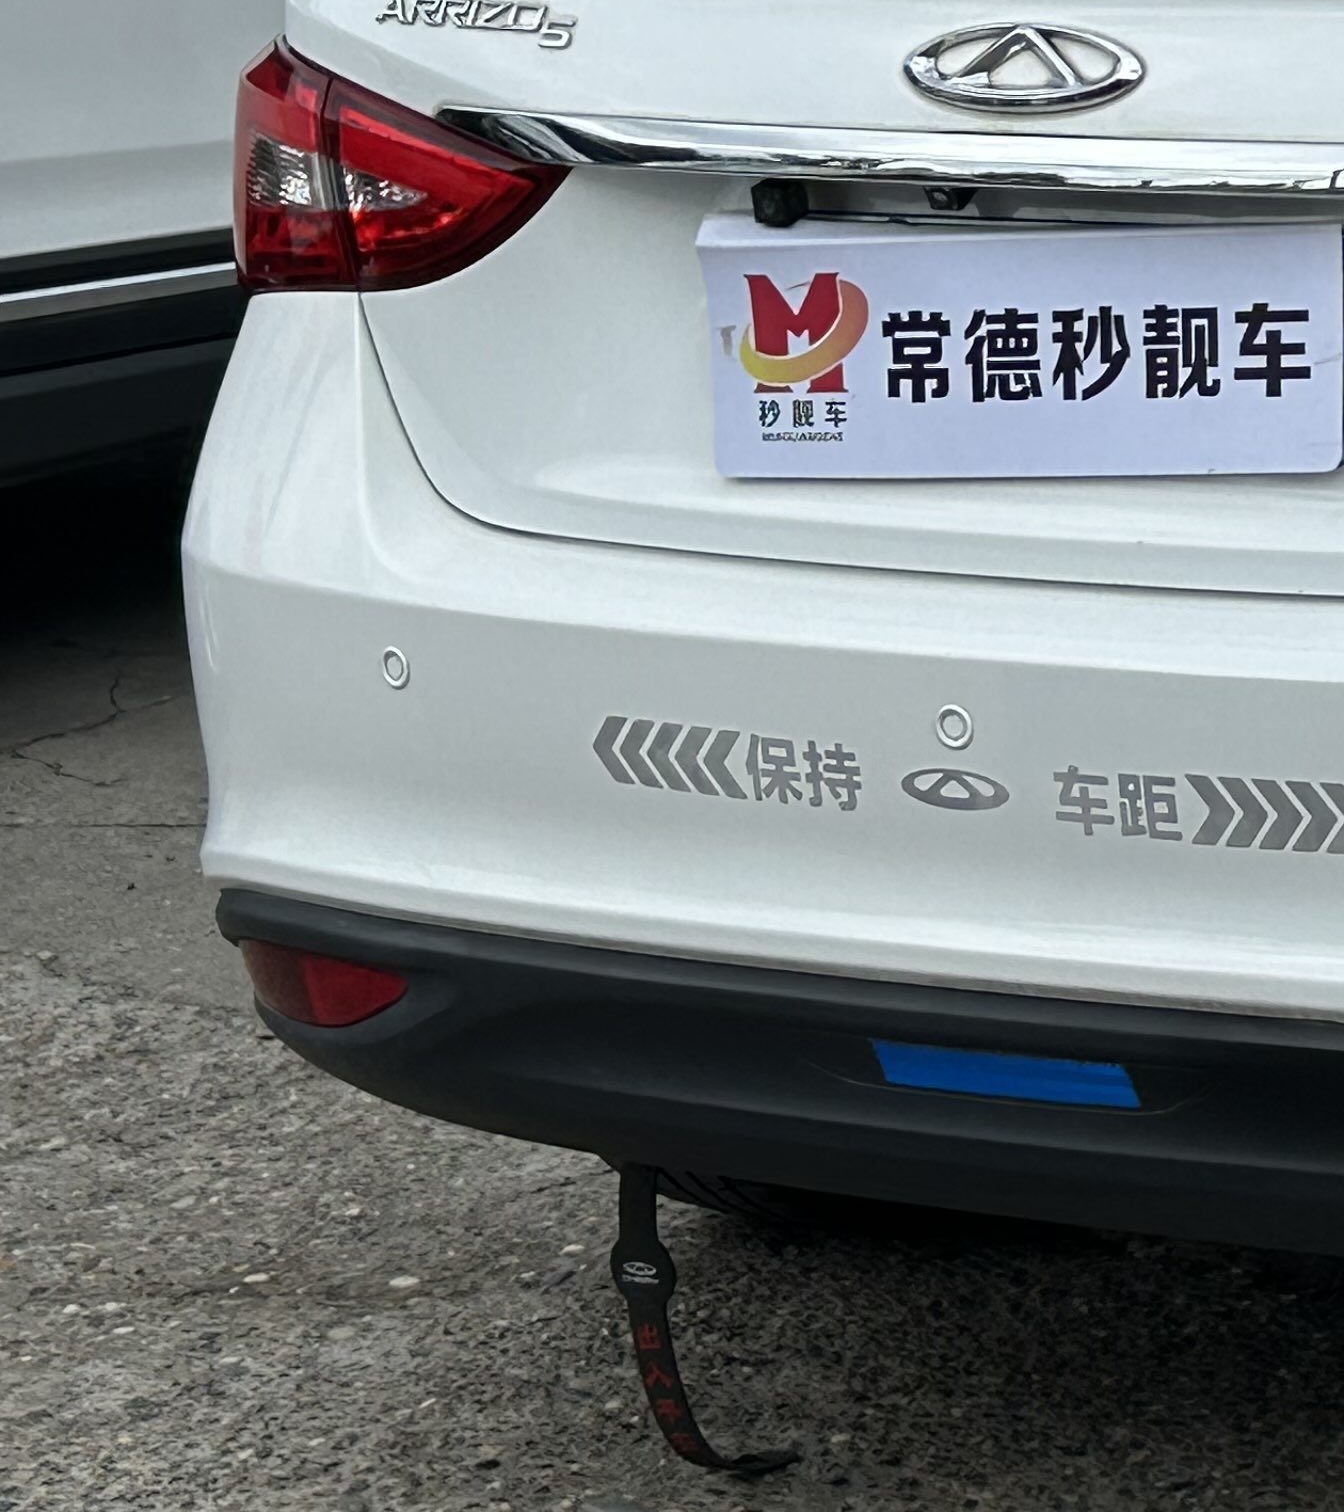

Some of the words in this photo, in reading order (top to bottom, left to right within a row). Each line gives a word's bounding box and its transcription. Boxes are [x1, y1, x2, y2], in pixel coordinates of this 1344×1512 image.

[881, 302, 1312, 404] 常德秒靓车
[745, 732, 863, 812] 保持
[1053, 764, 1183, 842] 车距
